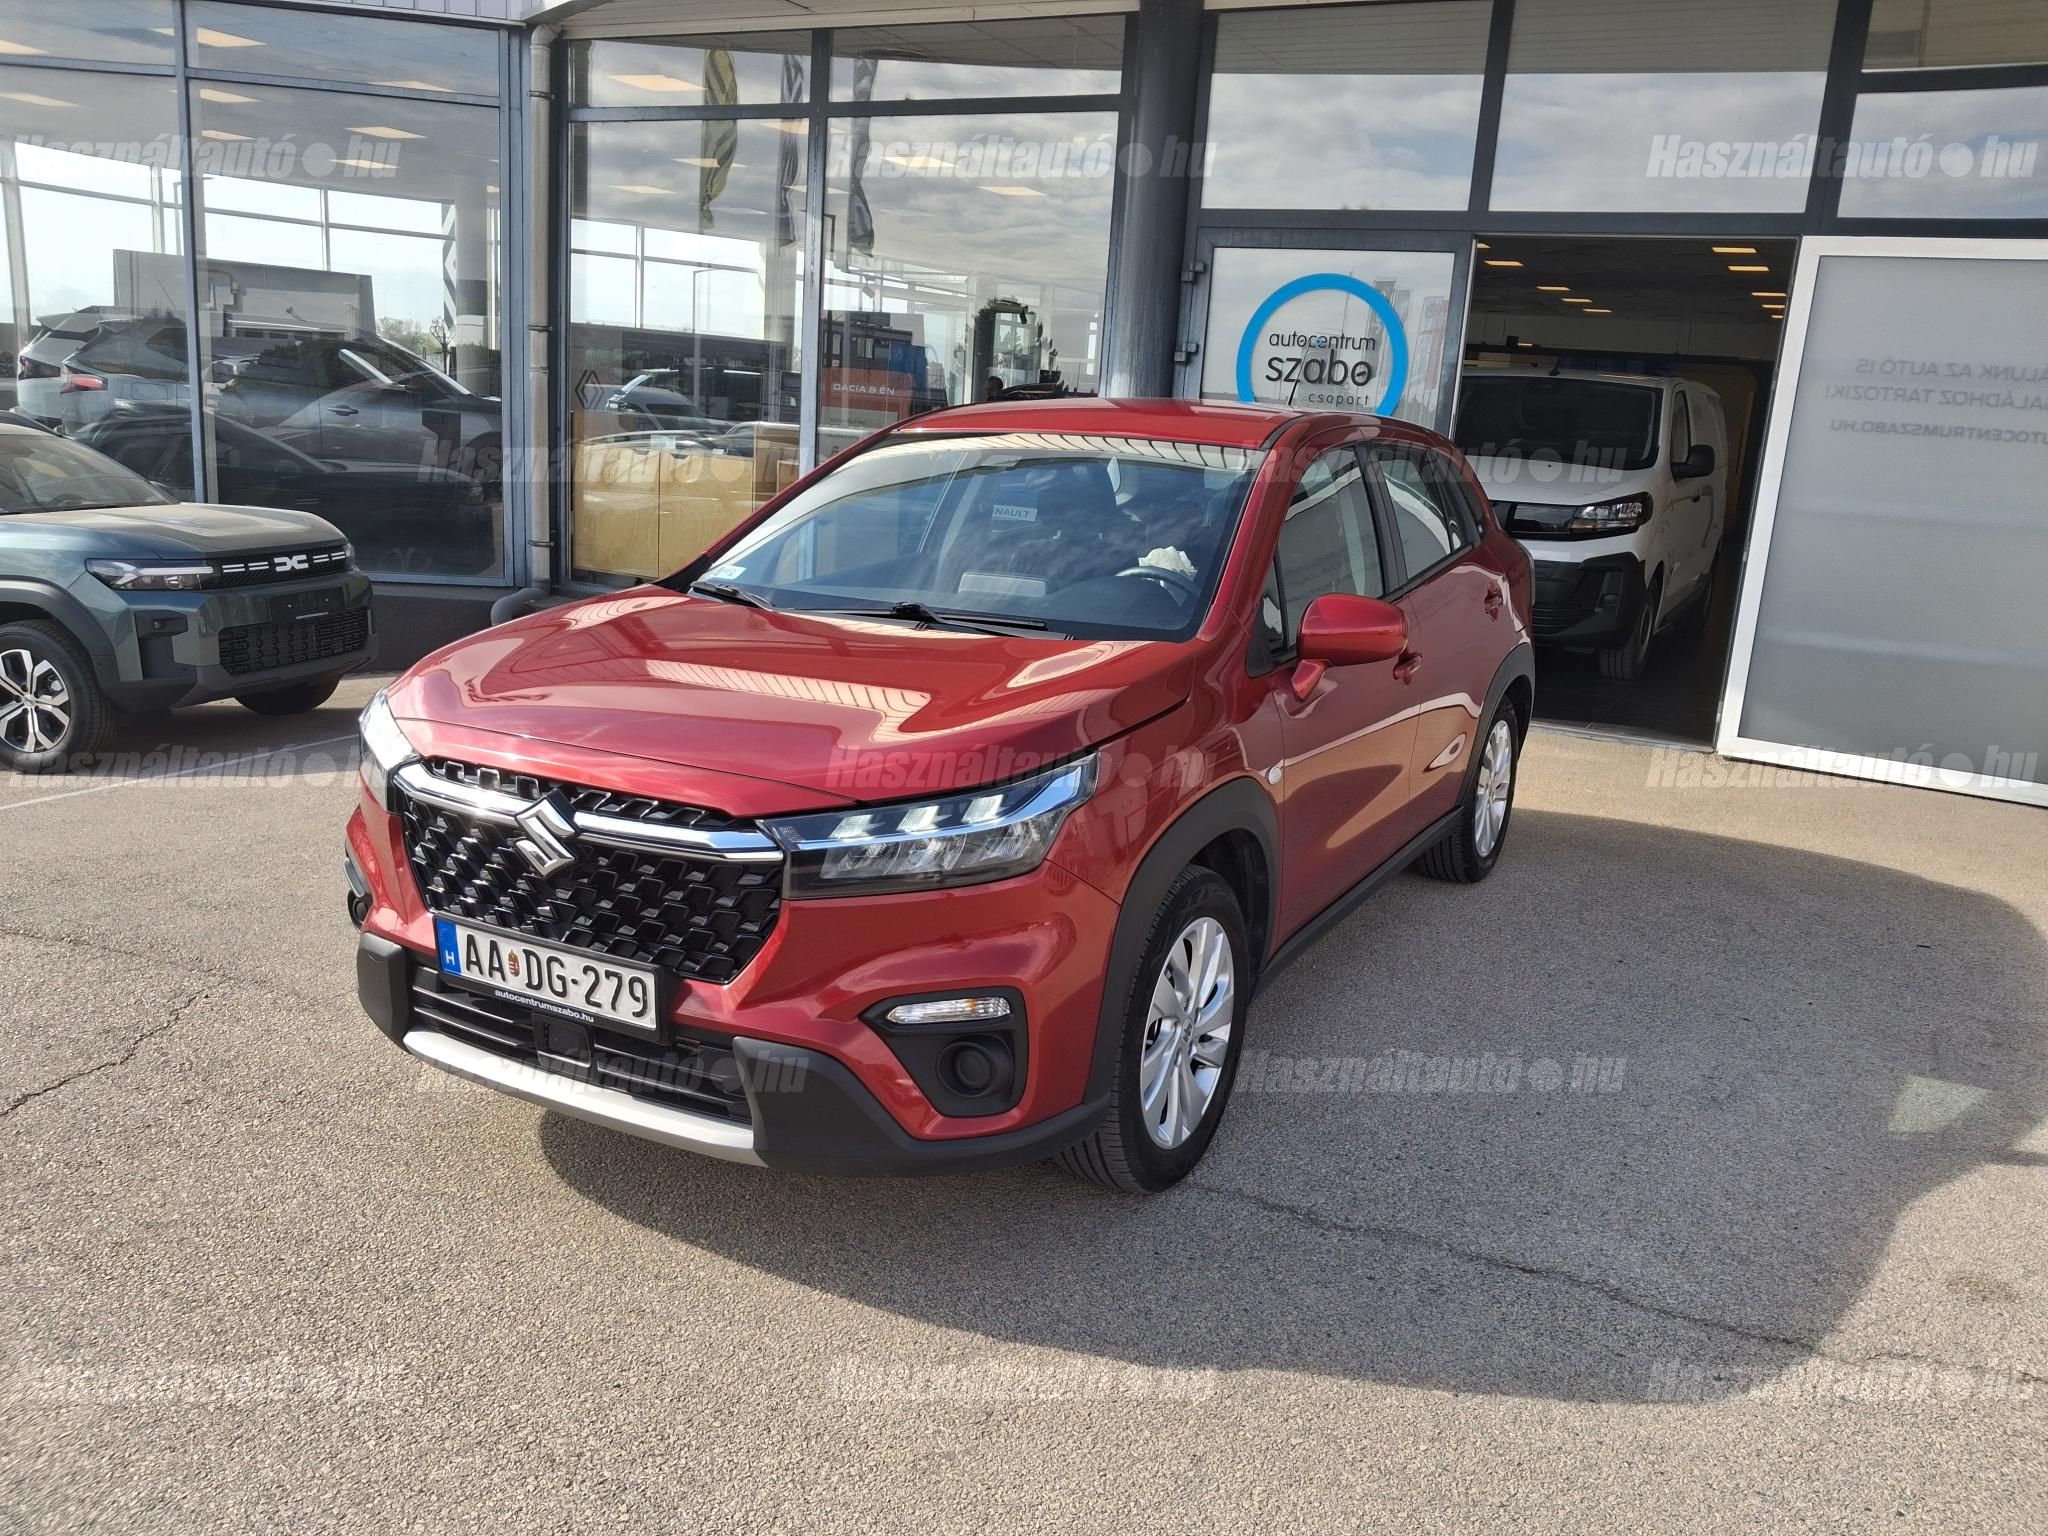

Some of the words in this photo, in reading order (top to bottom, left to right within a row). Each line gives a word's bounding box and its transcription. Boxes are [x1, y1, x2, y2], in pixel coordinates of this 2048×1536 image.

[1269, 331, 1376, 351] autocentrum
[833, 383, 866, 393] DACIA
[1308, 393, 1369, 407] csoport
[445, 951, 456, 966] H
[495, 988, 595, 1023] autocentrumszabo.hu
